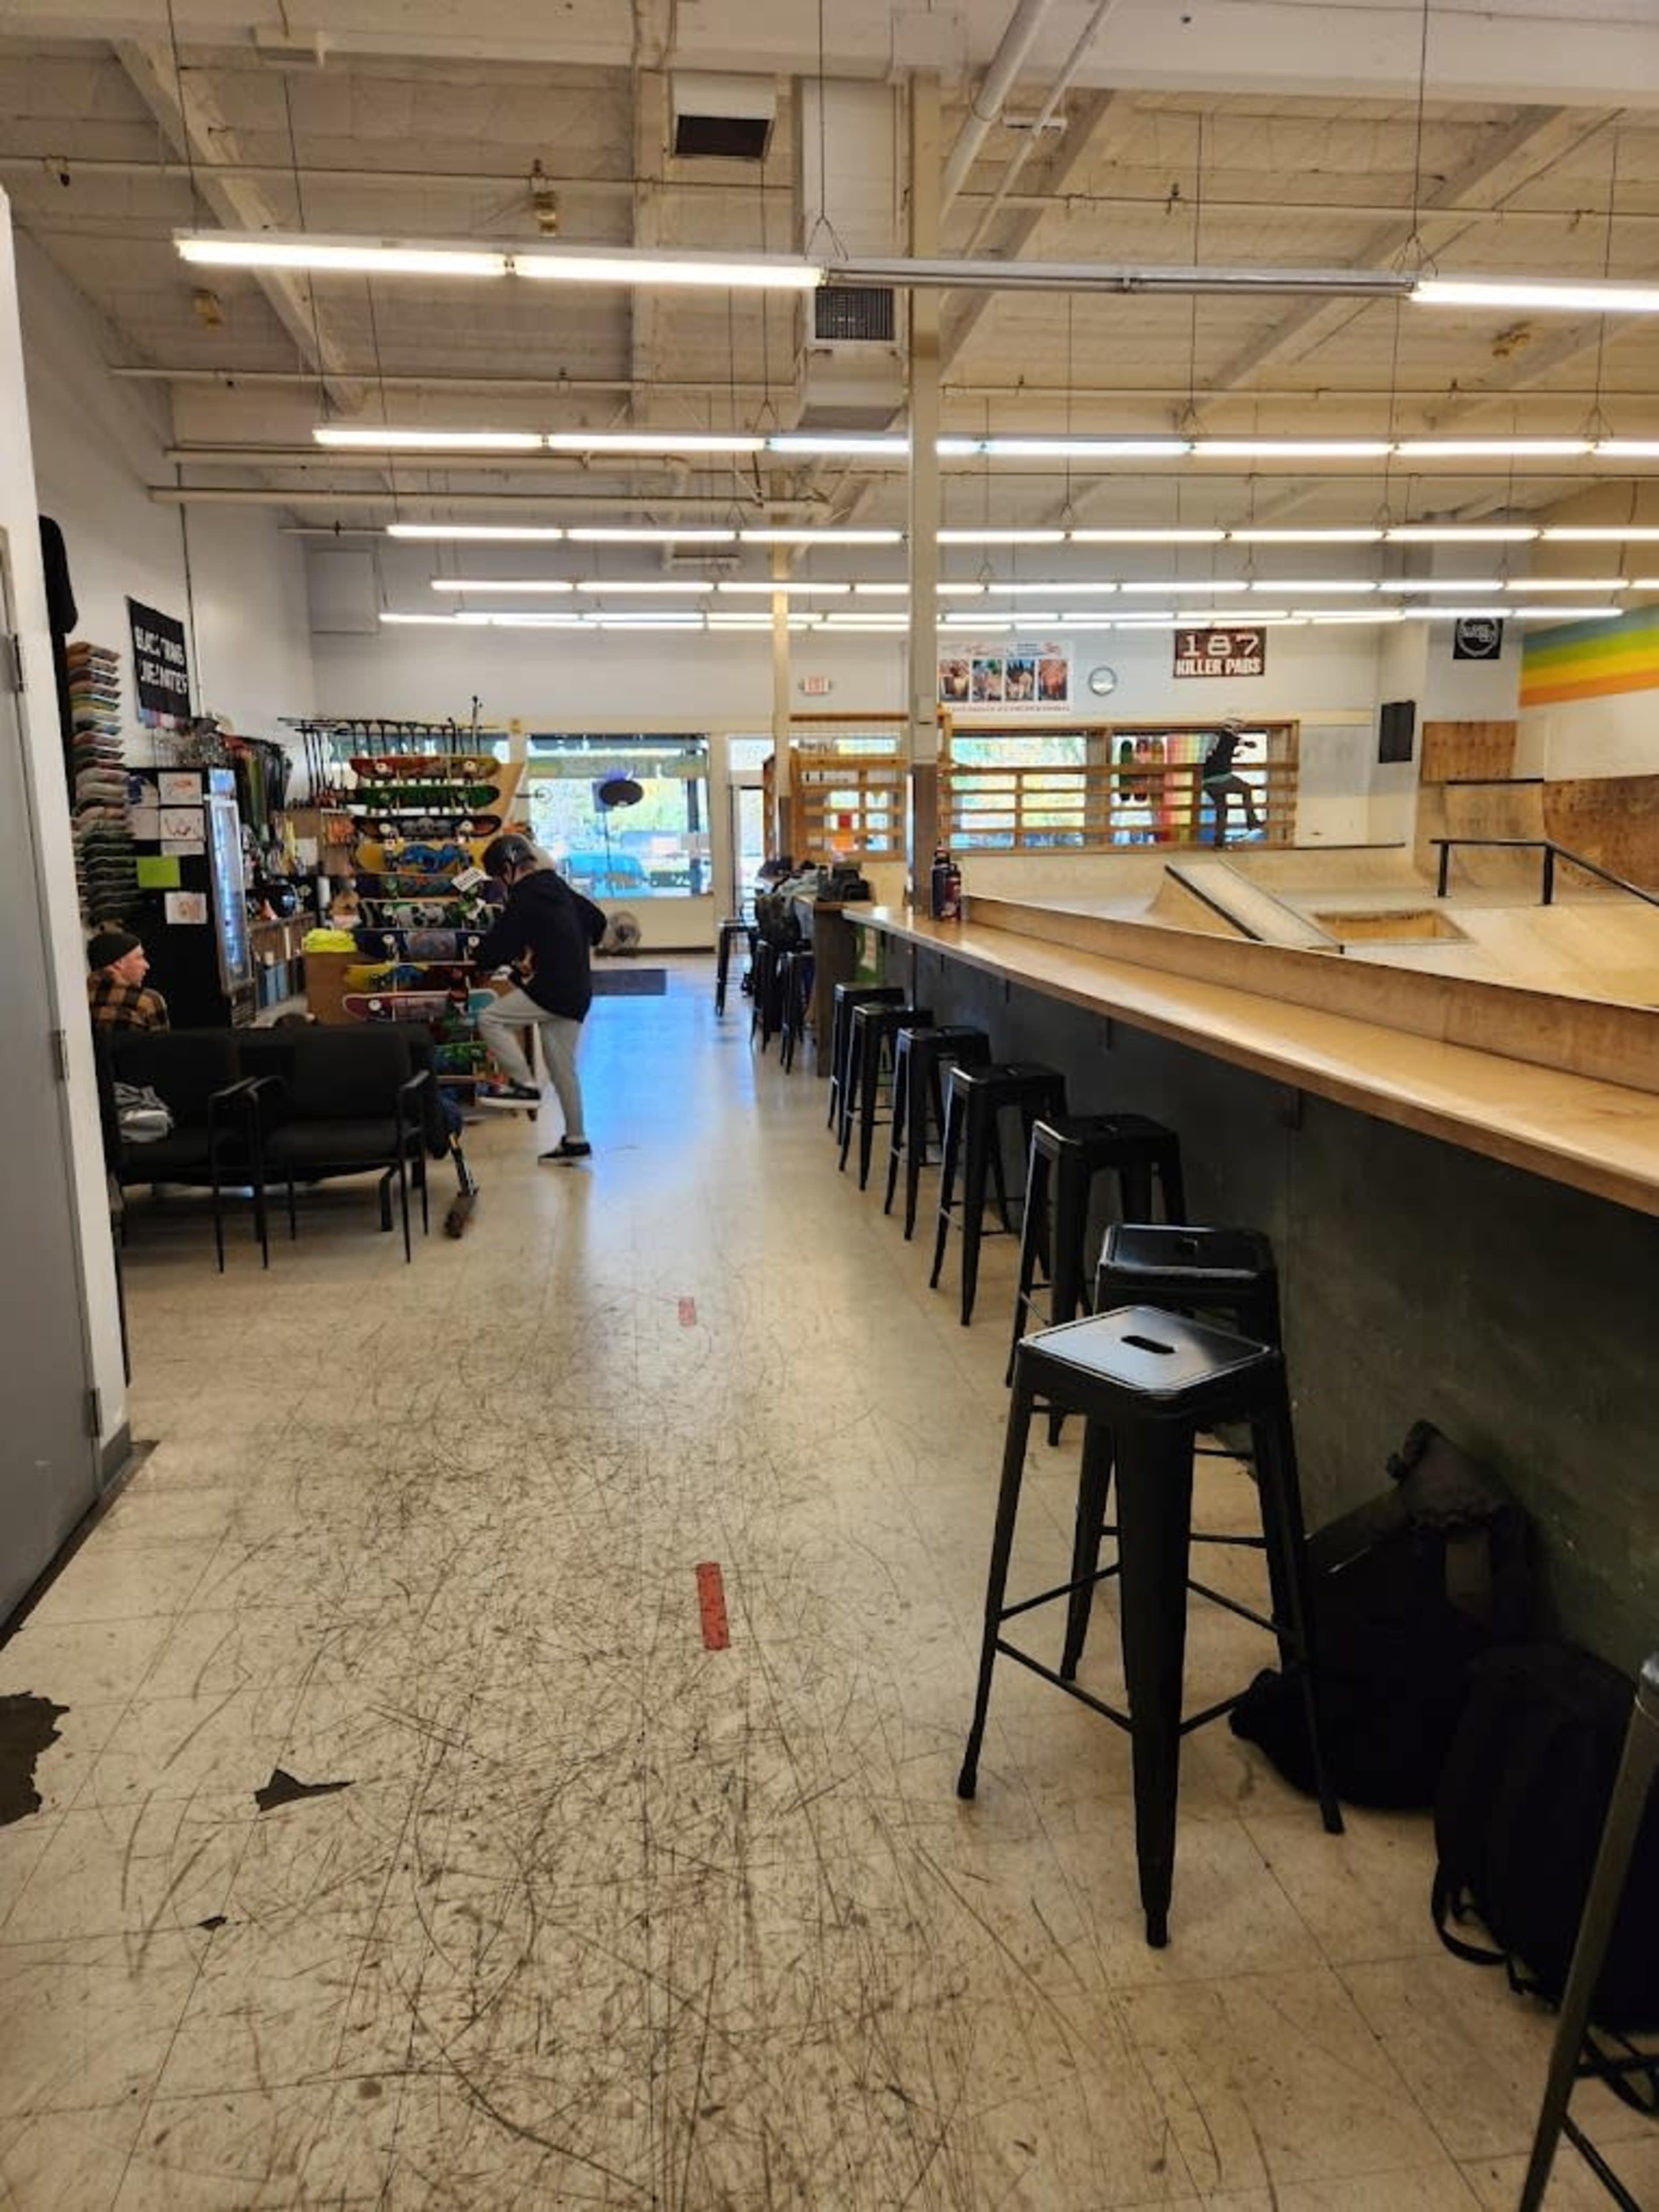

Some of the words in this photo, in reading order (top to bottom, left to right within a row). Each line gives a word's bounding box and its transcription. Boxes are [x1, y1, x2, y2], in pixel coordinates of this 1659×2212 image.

[1183, 633, 1259, 657] 187
[1177, 659, 1222, 675] KILLER
[1225, 658, 1261, 674] PADS
